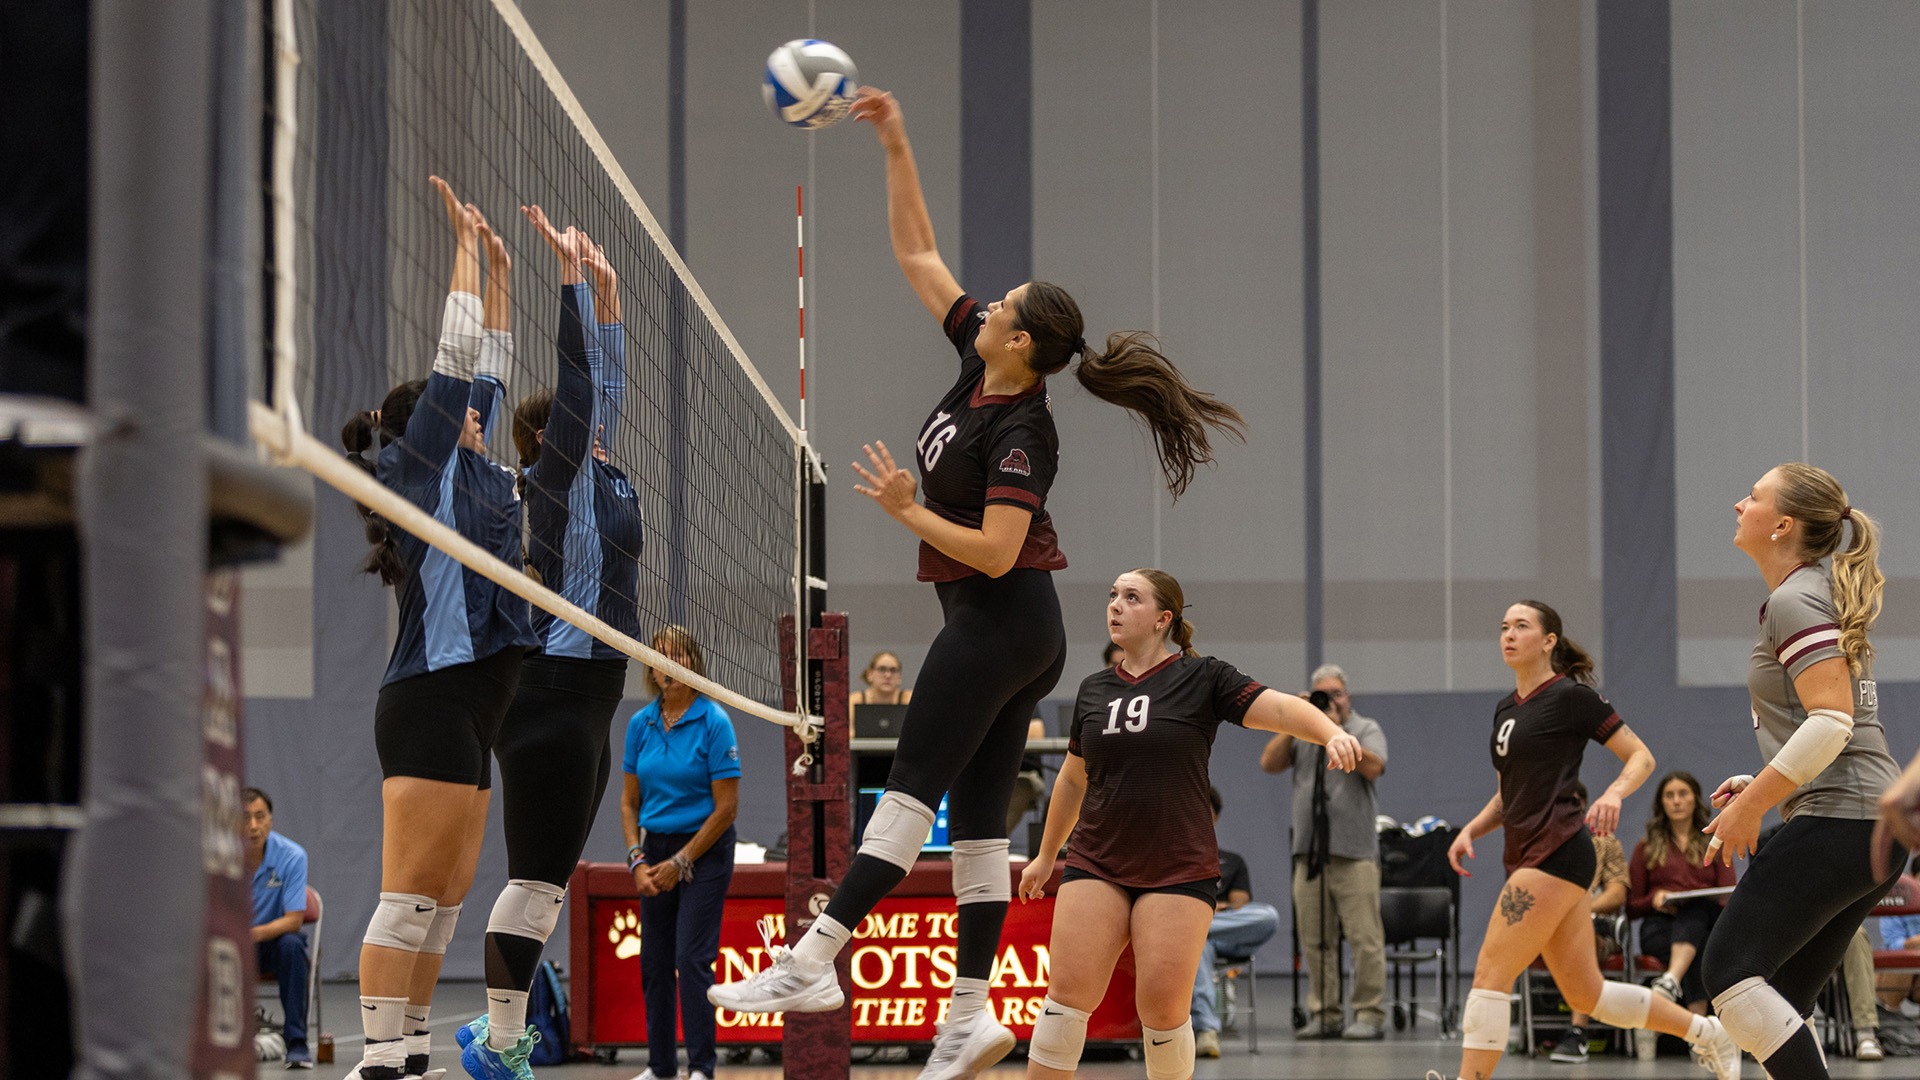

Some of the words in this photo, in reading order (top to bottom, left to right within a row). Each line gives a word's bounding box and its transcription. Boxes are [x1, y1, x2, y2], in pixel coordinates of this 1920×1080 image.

[917, 411, 957, 472] 16
[1102, 695, 1150, 735] 19
[1496, 719, 1516, 757] 9
[853, 997, 927, 1026] THE
